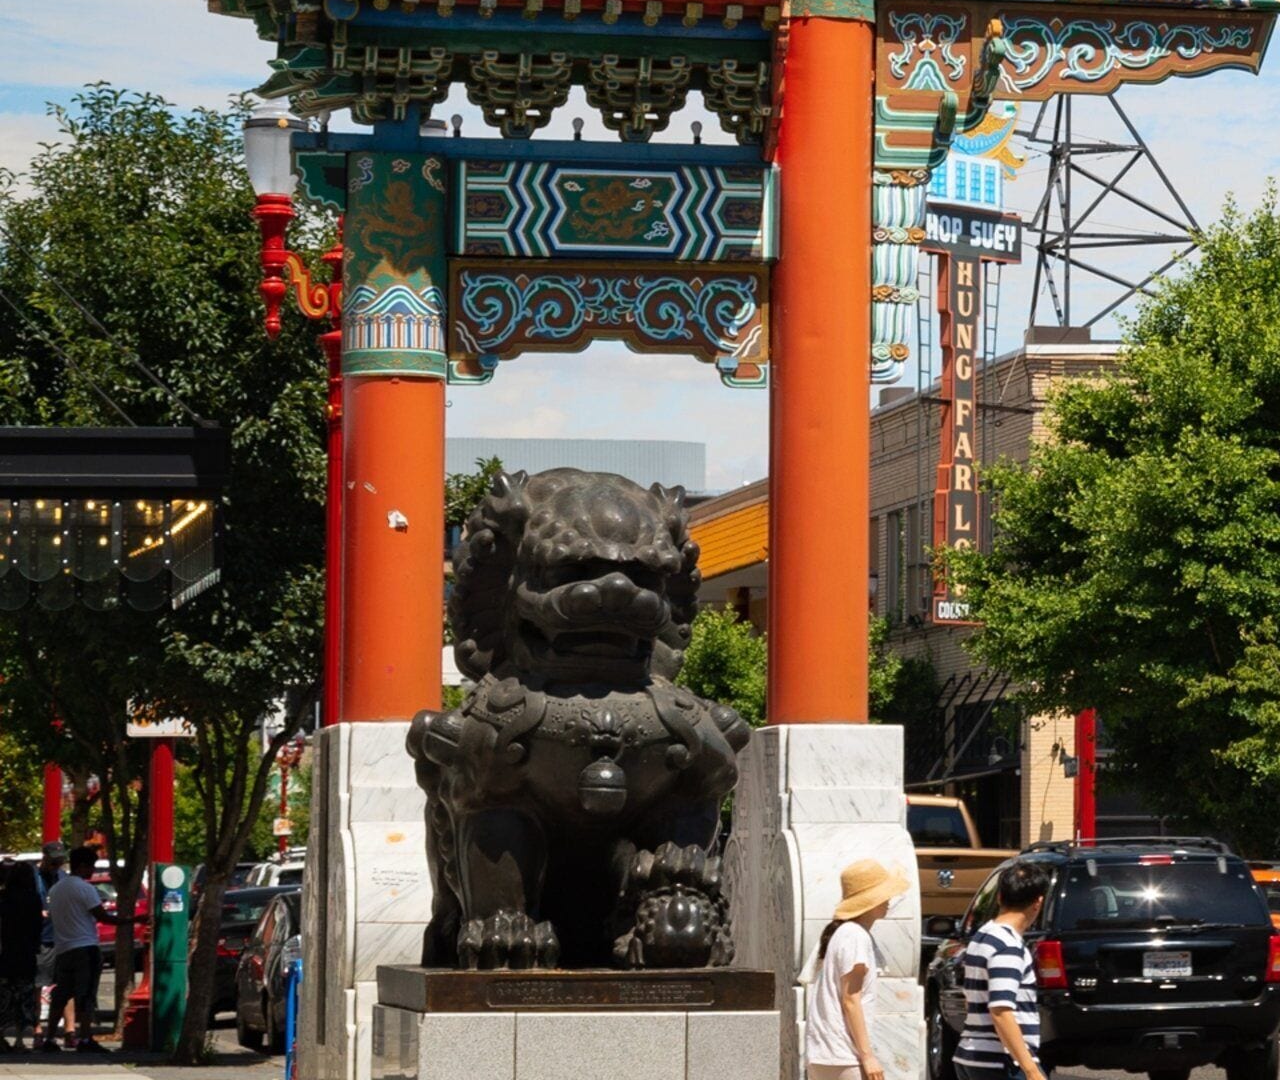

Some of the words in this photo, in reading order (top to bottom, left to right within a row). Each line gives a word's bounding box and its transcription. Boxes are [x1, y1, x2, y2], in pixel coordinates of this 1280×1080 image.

[925, 213, 963, 244] HOP
[970, 220, 1017, 253] SUEY
[955, 261, 974, 381] HUNG
[953, 400, 973, 491] FAR
